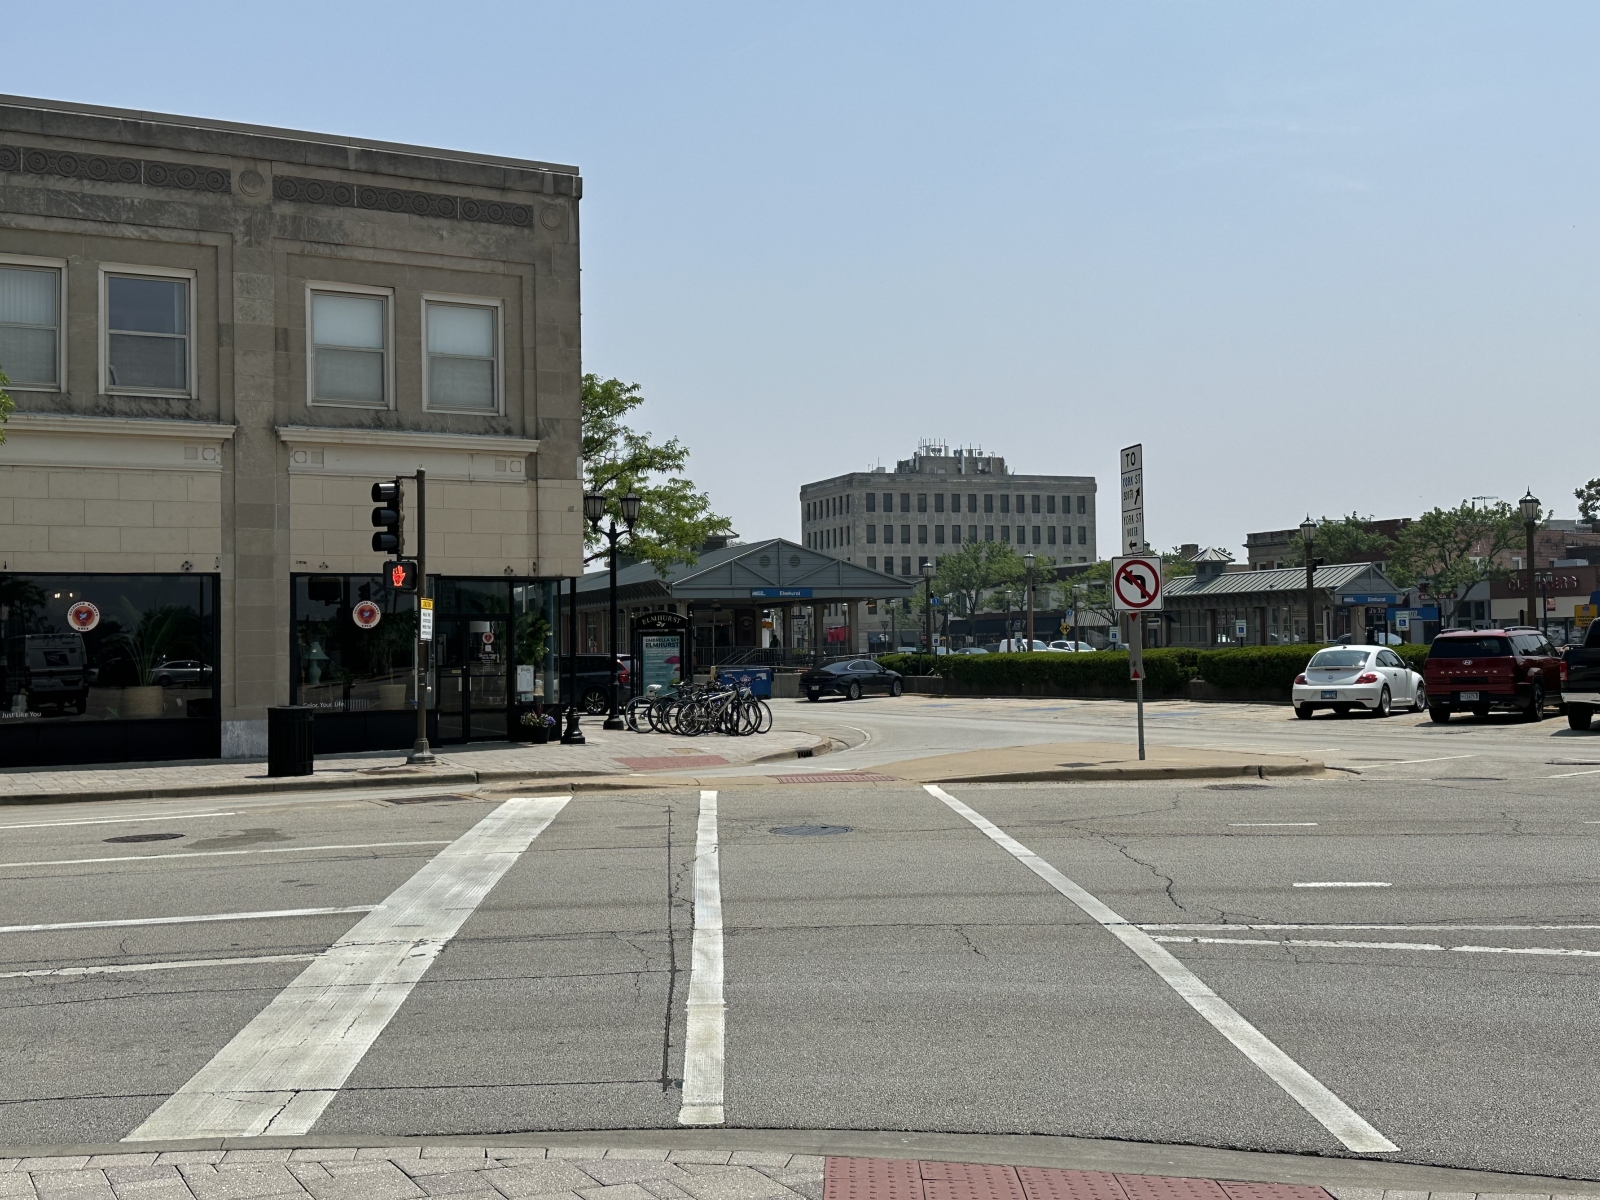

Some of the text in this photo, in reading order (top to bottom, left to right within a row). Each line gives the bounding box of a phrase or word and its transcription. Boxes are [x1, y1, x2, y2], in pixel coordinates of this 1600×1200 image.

[1125, 452, 1136, 467] TO
[1134, 474, 1141, 485] ST
[1135, 513, 1142, 523] ST
[641, 614, 682, 625] ELMHURST
